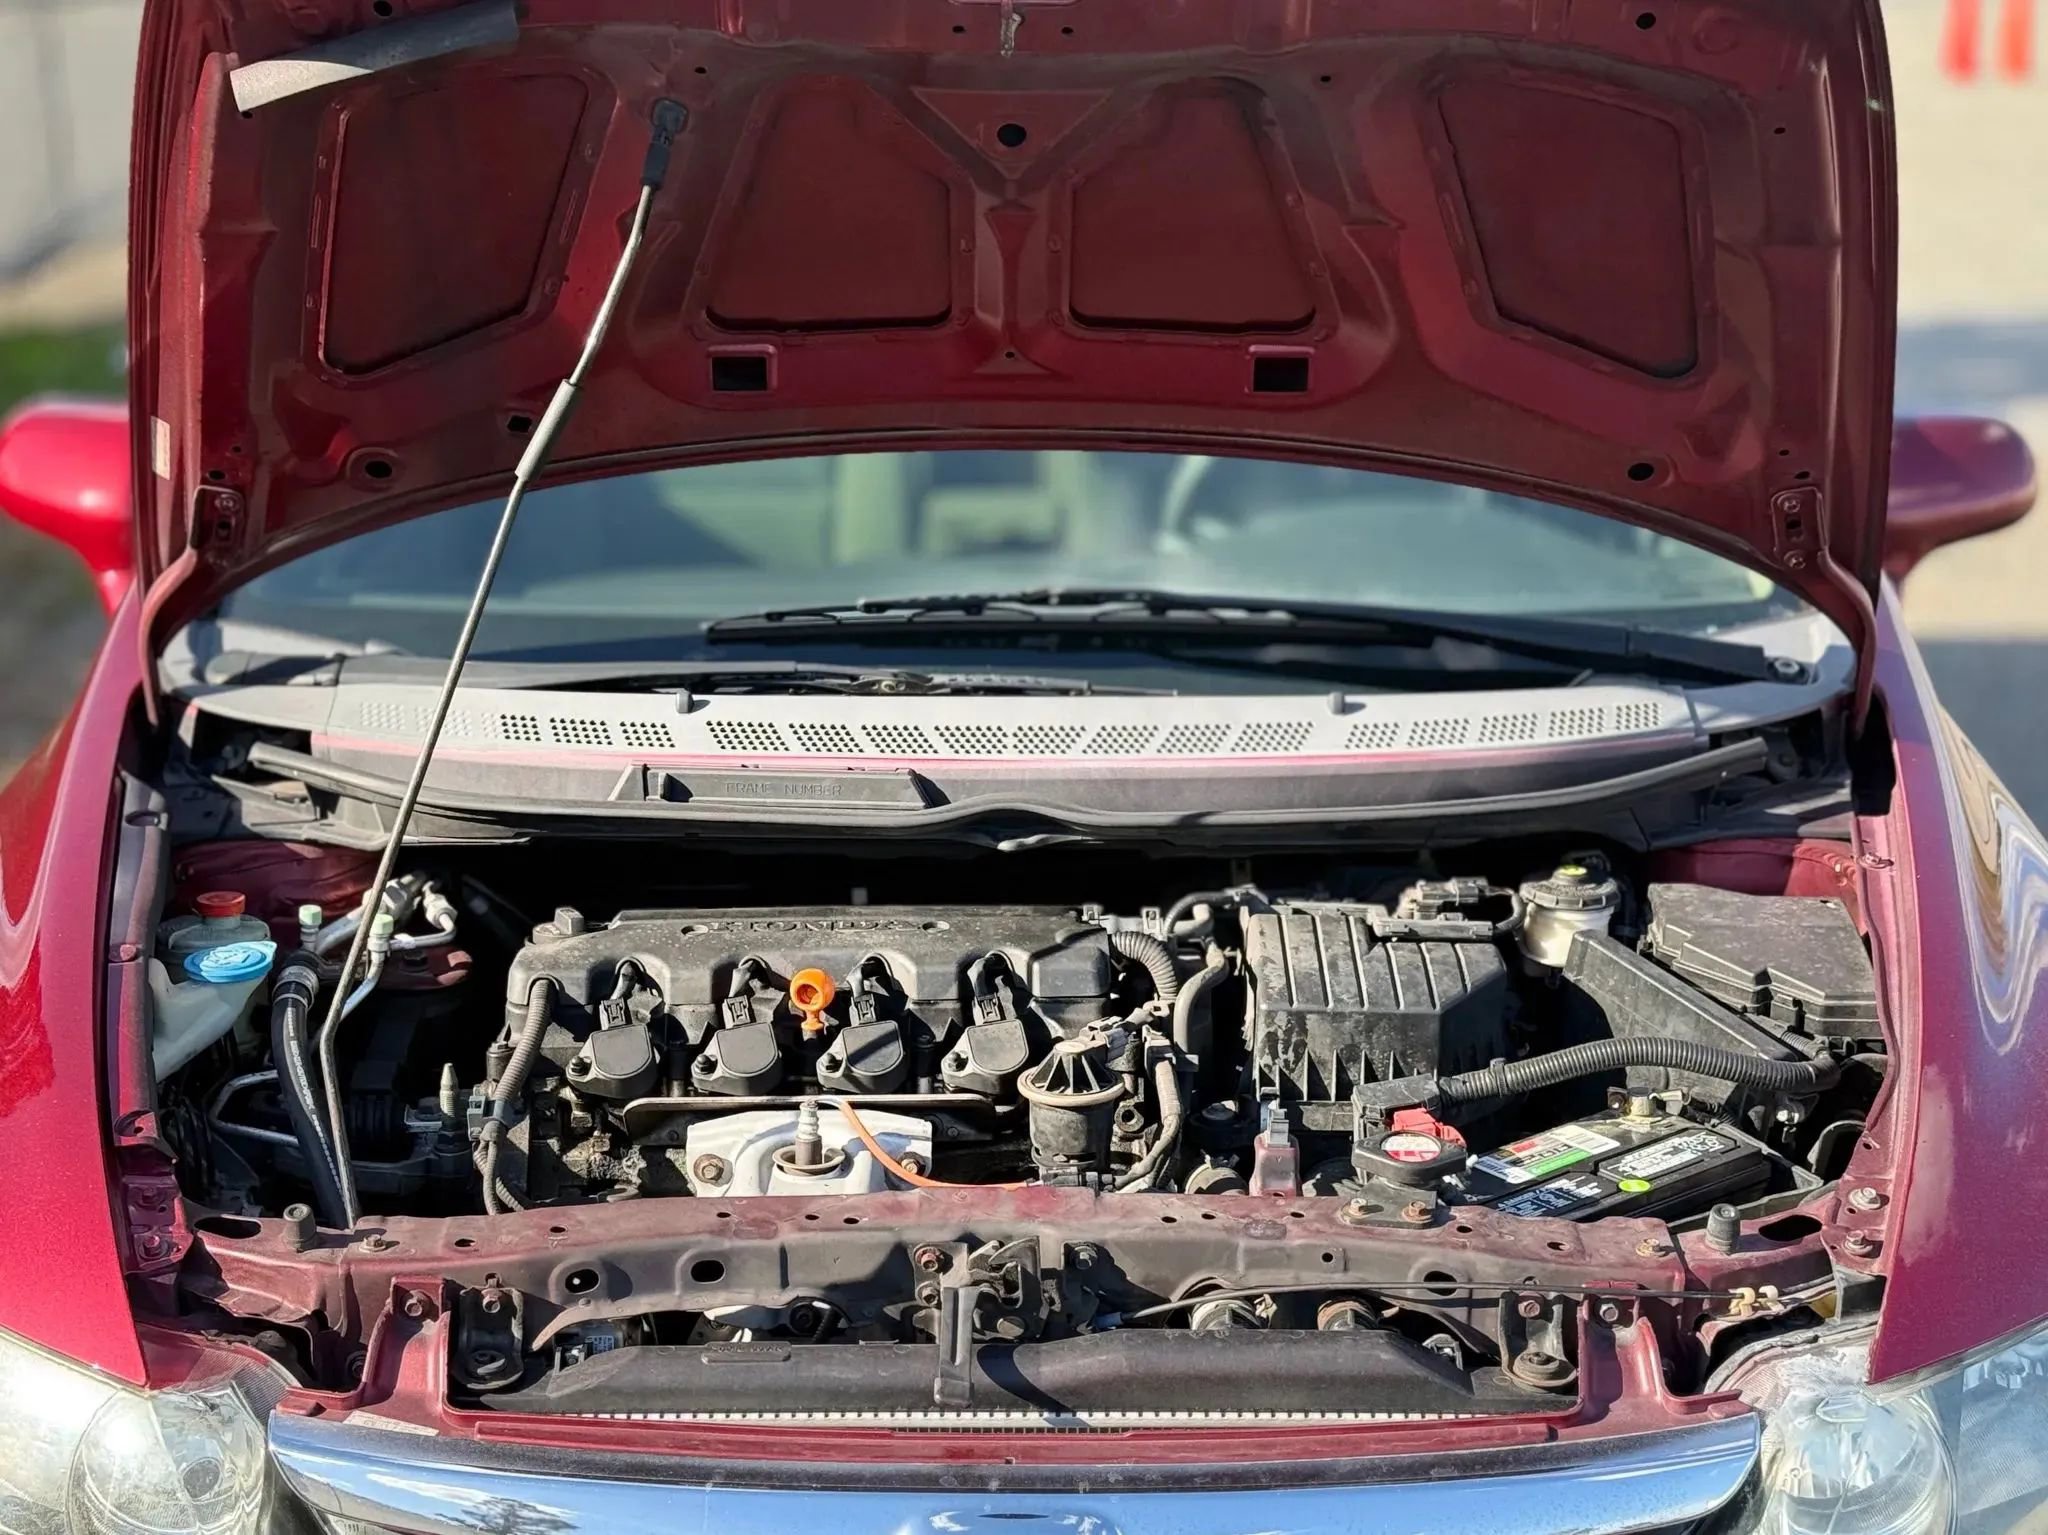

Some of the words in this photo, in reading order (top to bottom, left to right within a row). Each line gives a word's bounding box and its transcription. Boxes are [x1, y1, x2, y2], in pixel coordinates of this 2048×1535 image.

[726, 782, 771, 794] FRAME
[784, 783, 843, 797] NUMBER
[708, 919, 921, 933] HONDA
